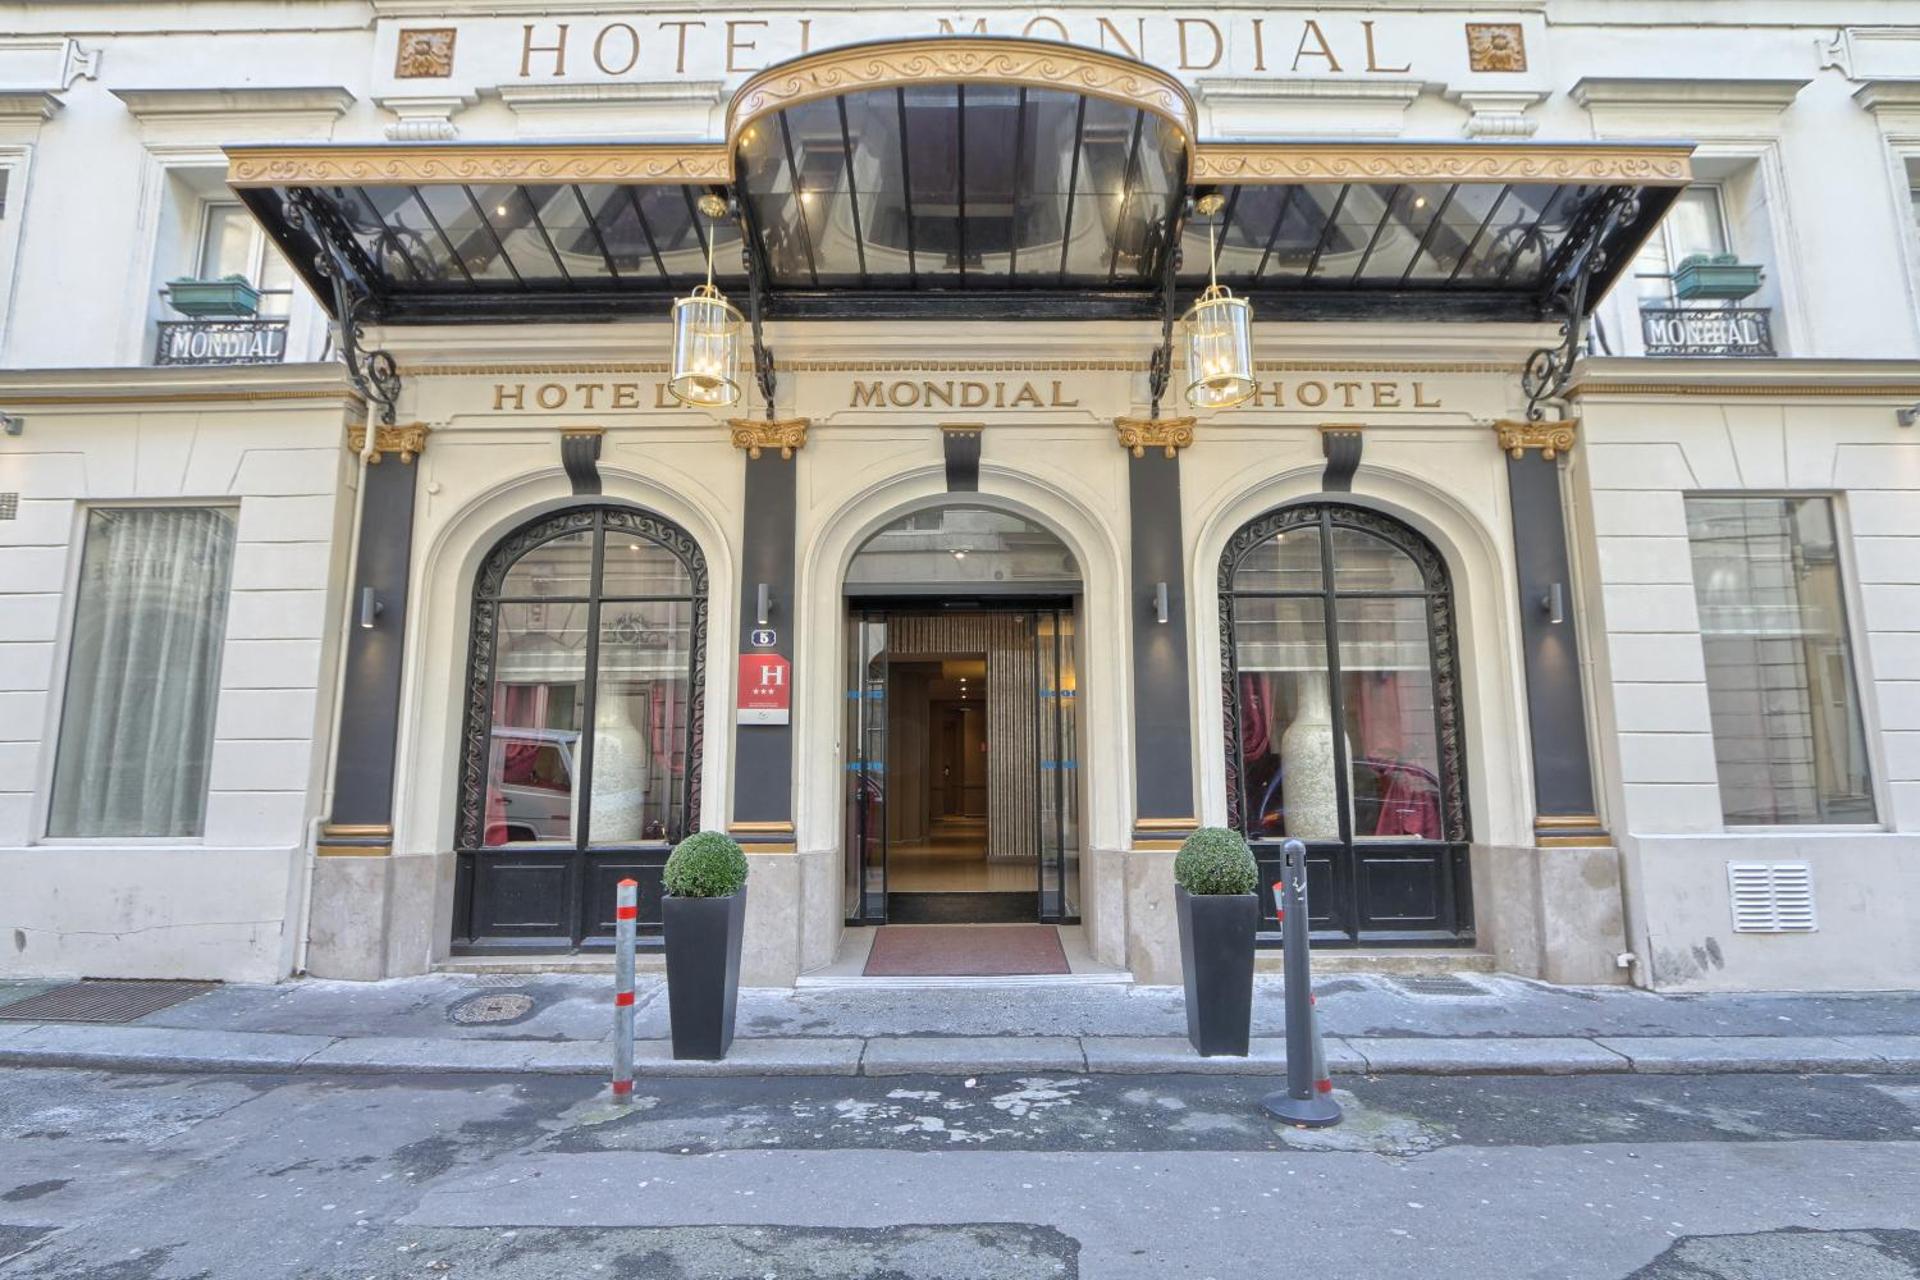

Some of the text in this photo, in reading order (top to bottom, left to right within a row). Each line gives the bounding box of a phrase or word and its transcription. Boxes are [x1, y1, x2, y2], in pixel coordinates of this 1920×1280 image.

[937, 16, 1411, 73] NDIAL
[170, 331, 280, 358] MONDIAL
[492, 383, 682, 410] HOTEL
[850, 380, 1079, 408] MONDIAL
[1253, 380, 1441, 408] HOTEL
[760, 665, 785, 686] H
